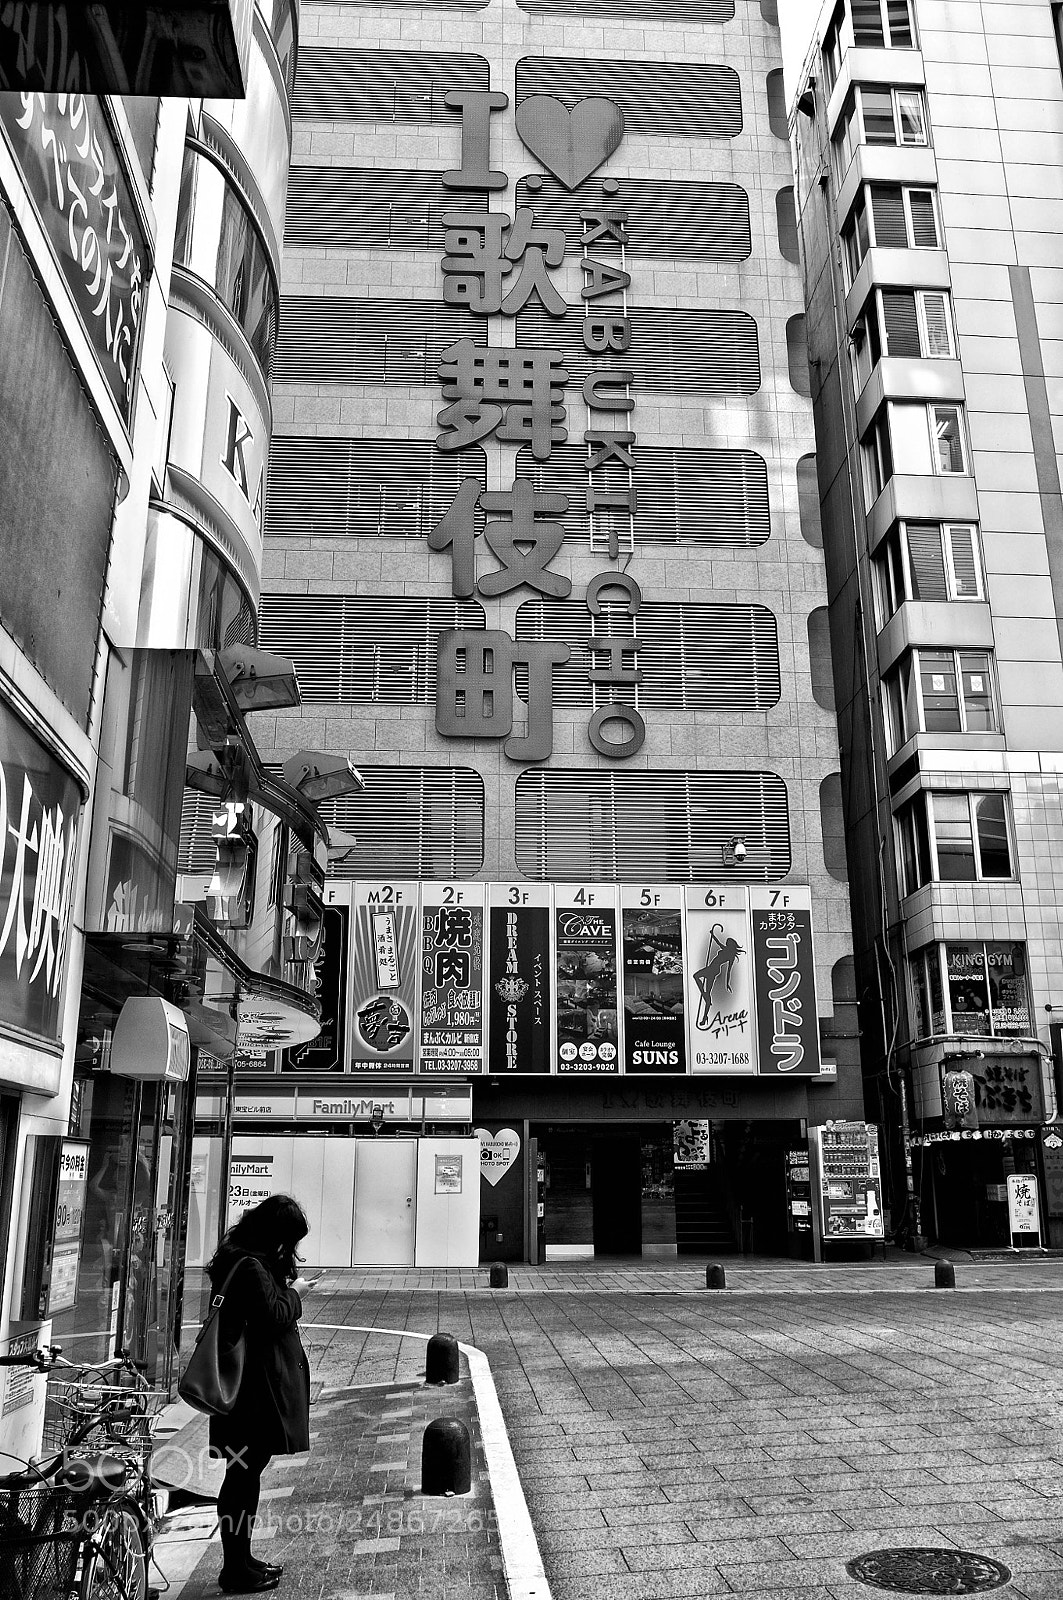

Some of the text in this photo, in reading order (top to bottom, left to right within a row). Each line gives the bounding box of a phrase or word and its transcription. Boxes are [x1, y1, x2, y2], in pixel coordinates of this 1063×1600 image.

[57, 92, 141, 328] のライブを
[427, 207, 572, 761] 歌舞伎町
[579, 210, 646, 758] KABUKI-CHO
[367, 886, 403, 904] M2F
[442, 887, 464, 904] 2F
[508, 887, 529, 905] 3F
[573, 888, 595, 906] 4F
[639, 889, 661, 907] 5F
[704, 889, 726, 908] 6F
[768, 890, 790, 908] 7F
[768, 912, 796, 922] まわる
[759, 921, 805, 931] カウンター
[422, 915, 434, 975] BBQ
[434, 906, 473, 989] 焼肉
[506, 912, 518, 974] DREAM
[952, 953, 1013, 966] KING GYM
[765, 932, 805, 1072] ゴンドラ
[710, 1009, 749, 1026] Arena
[423, 1031, 463, 1045] まんぷくカルビ
[506, 1003, 518, 1069] STORE
[711, 1020, 748, 1039] アリーナ
[634, 1040, 676, 1050] Cafe Lounge
[235, 1059, 267, 1069] 05-6864
[632, 1050, 679, 1065] SUNS
[696, 1052, 750, 1065] 03-3207-1688
[560, 1063, 615, 1071] 03-3203-9020
[234, 1106, 272, 1114] 東宝ビル前店
[312, 1099, 395, 1116] FamilyMart
[230, 1164, 269, 1175] milyMart
[1014, 1183, 1031, 1200] 焼
